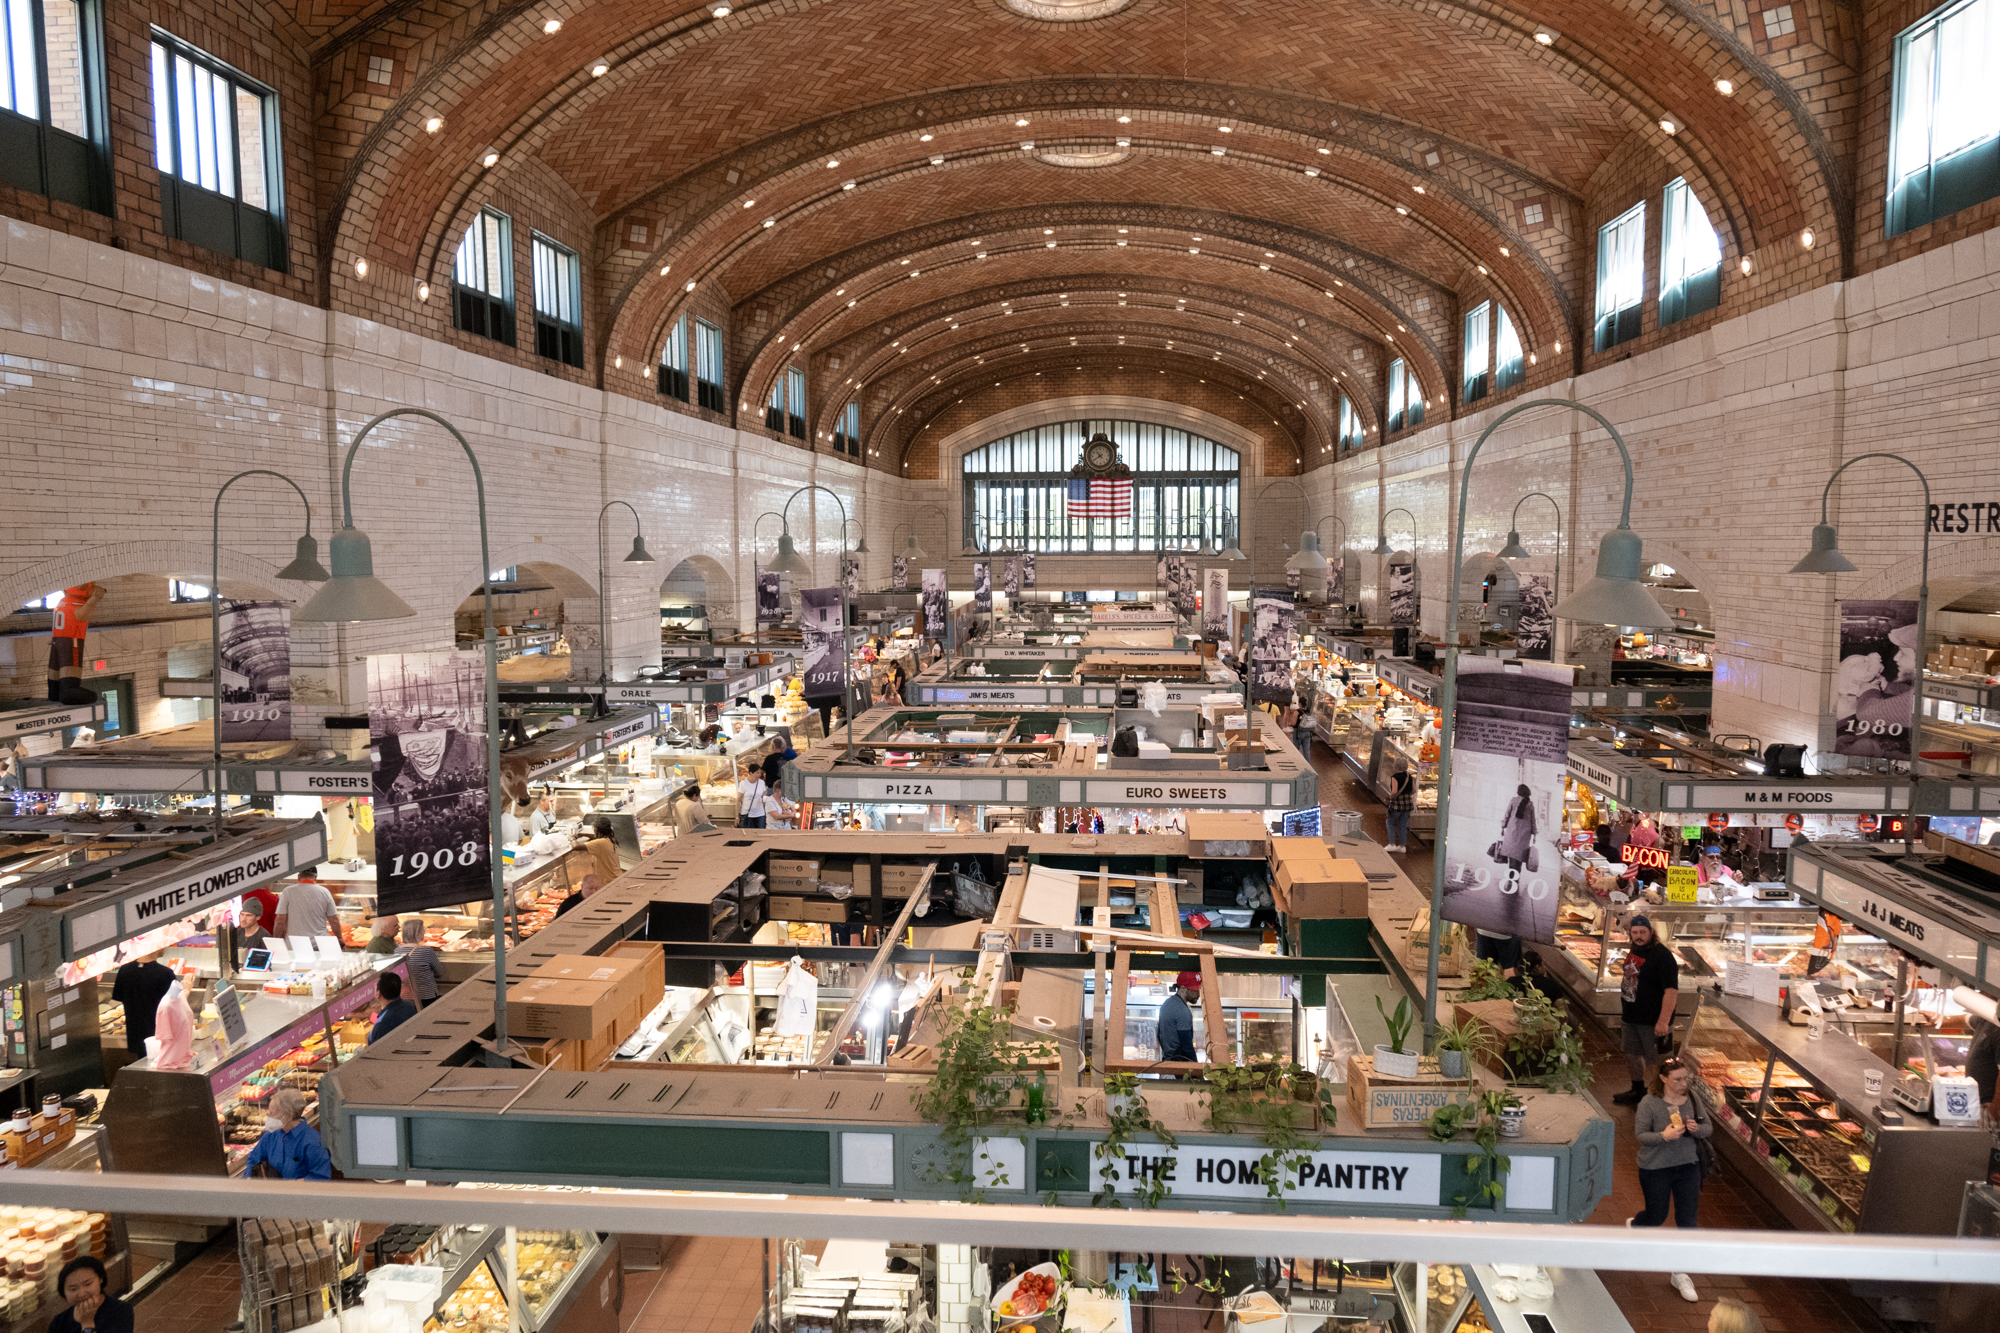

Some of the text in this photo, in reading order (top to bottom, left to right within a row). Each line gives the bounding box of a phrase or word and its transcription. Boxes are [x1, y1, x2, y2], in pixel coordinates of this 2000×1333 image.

[1522, 639, 1547, 649] 1977
[810, 670, 839, 684] 1917
[1257, 674, 1287, 687] 1977
[16, 714, 71, 730] MEISTER FOODS
[230, 708, 281, 724] 1910
[612, 726, 631, 739] FOSTER'S
[1844, 718, 1903, 736] 1980
[308, 777, 369, 788] FOSTER'S
[886, 785, 933, 794] PIZZA
[1126, 788, 1227, 799] EURO SWEETS
[1745, 792, 1833, 803] M & M FOODS
[390, 841, 478, 879] 1908
[1622, 844, 1670, 869] BACON
[136, 852, 281, 920] WHITE FLOWER CAKE
[1452, 862, 1549, 900] 1980
[1670, 877, 1696, 885] BACON
[1671, 891, 1694, 900] BACK!
[1863, 900, 1925, 941] J & J MEATS
[1866, 1077, 1882, 1086] TIPS
[1376, 1092, 1448, 1107] ARGENTINAS
[1393, 1108, 1428, 1121] PERAS
[1586, 1144, 1598, 1172] D
[1125, 1155, 1409, 1191] THE HOM PANTRY
[1309, 1299, 1338, 1313] WRAPS
